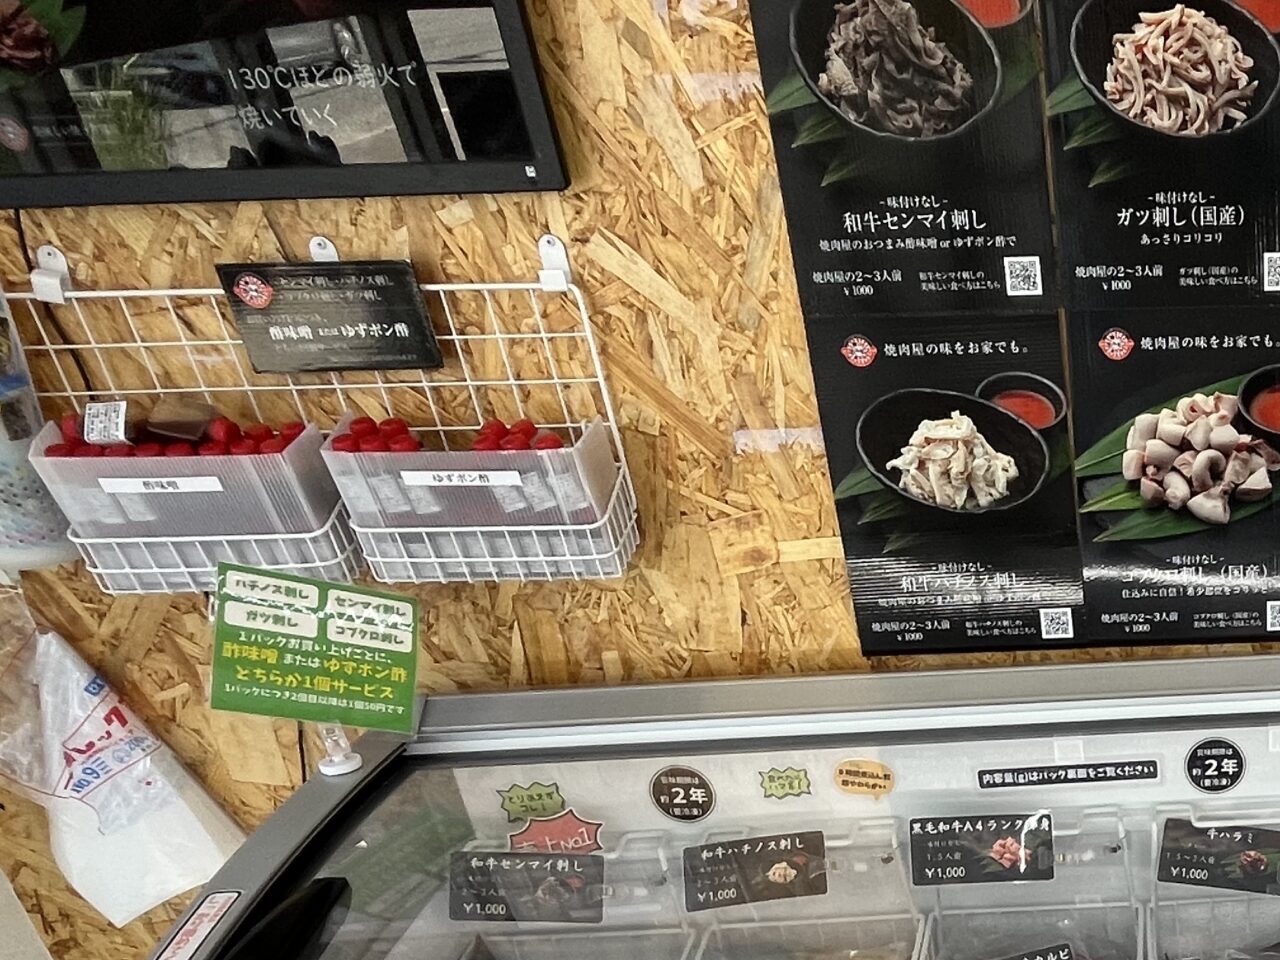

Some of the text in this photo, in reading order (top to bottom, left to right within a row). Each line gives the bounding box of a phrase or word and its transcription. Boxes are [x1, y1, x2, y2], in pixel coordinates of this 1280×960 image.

[240, 103, 339, 129] 焼いていく
[843, 209, 987, 233] 和牛センマイ刺し
[940, 239, 950, 249] or
[953, 236, 1017, 249] ゆずポン酢で
[1140, 232, 1223, 245] あっさりコリコリ
[341, 322, 410, 338] ゆずポン酢
[884, 341, 1028, 357] 焼肉屋の味をお家でも。
[431, 471, 490, 486] ゆずポン酢
[235, 578, 310, 600] ハチノス刺し
[246, 609, 405, 645] ガツ刺し コブクロ刺し
[221, 641, 408, 684] 酢味噌 または ゆずポン酢
[1205, 827, 1256, 845] 牛ハラミ
[700, 838, 806, 861] 和牛ハチノス刺し
[470, 856, 585, 873] 和牛センマイ刺し
